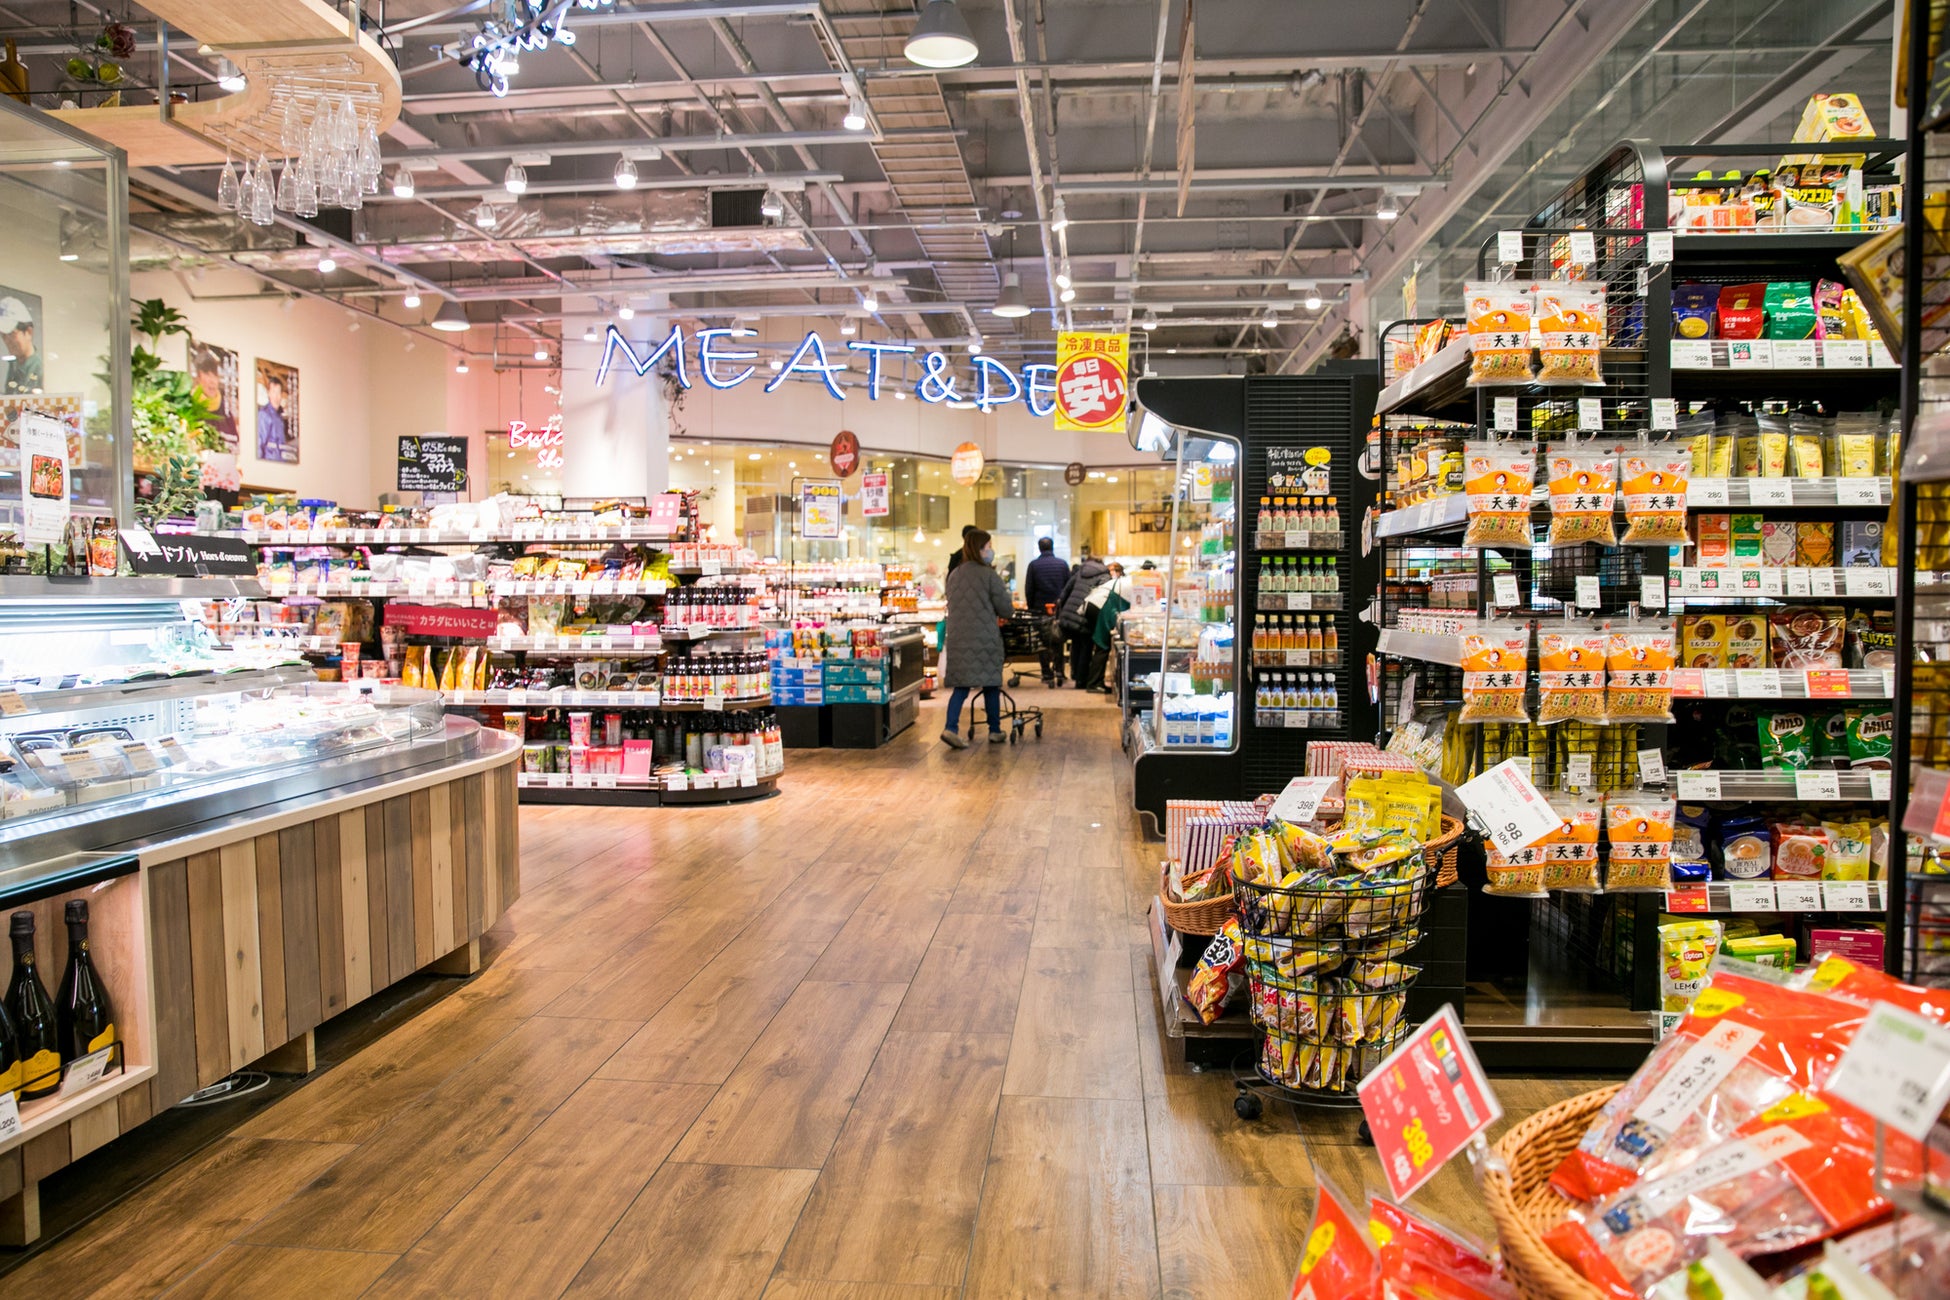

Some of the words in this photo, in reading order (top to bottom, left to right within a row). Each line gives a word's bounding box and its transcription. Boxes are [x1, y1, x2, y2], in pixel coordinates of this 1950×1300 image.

[1785, 187, 1833, 203] ミルクココア
[1064, 337, 1121, 353] 冷凍食品
[1493, 333, 1520, 348] 天華
[1563, 333, 1590, 348] 天華
[1072, 358, 1099, 375] 毎日
[1061, 374, 1125, 417] 安い
[1491, 496, 1519, 510] 天華
[1574, 496, 1602, 510] 天華
[1649, 496, 1676, 510] 天華
[200, 551, 219, 561] Hors
[1485, 672, 1514, 688] 天華
[1563, 672, 1592, 688] 天華
[1630, 672, 1658, 688] 天華
[1773, 716, 1803, 731] MILO
[1863, 718, 1892, 733] MILO
[1298, 800, 1315, 810] 398
[1504, 821, 1523, 841] 98
[1496, 831, 1510, 847] 106
[1830, 839, 1864, 854] Cレモン
[1556, 845, 1585, 860] 天華
[1631, 844, 1659, 859] 天華
[1684, 951, 1704, 960] Lipton
[1674, 981, 1700, 990] LEMO
[1650, 1053, 1717, 1120] かつおパック
[1402, 1117, 1433, 1168] 398
